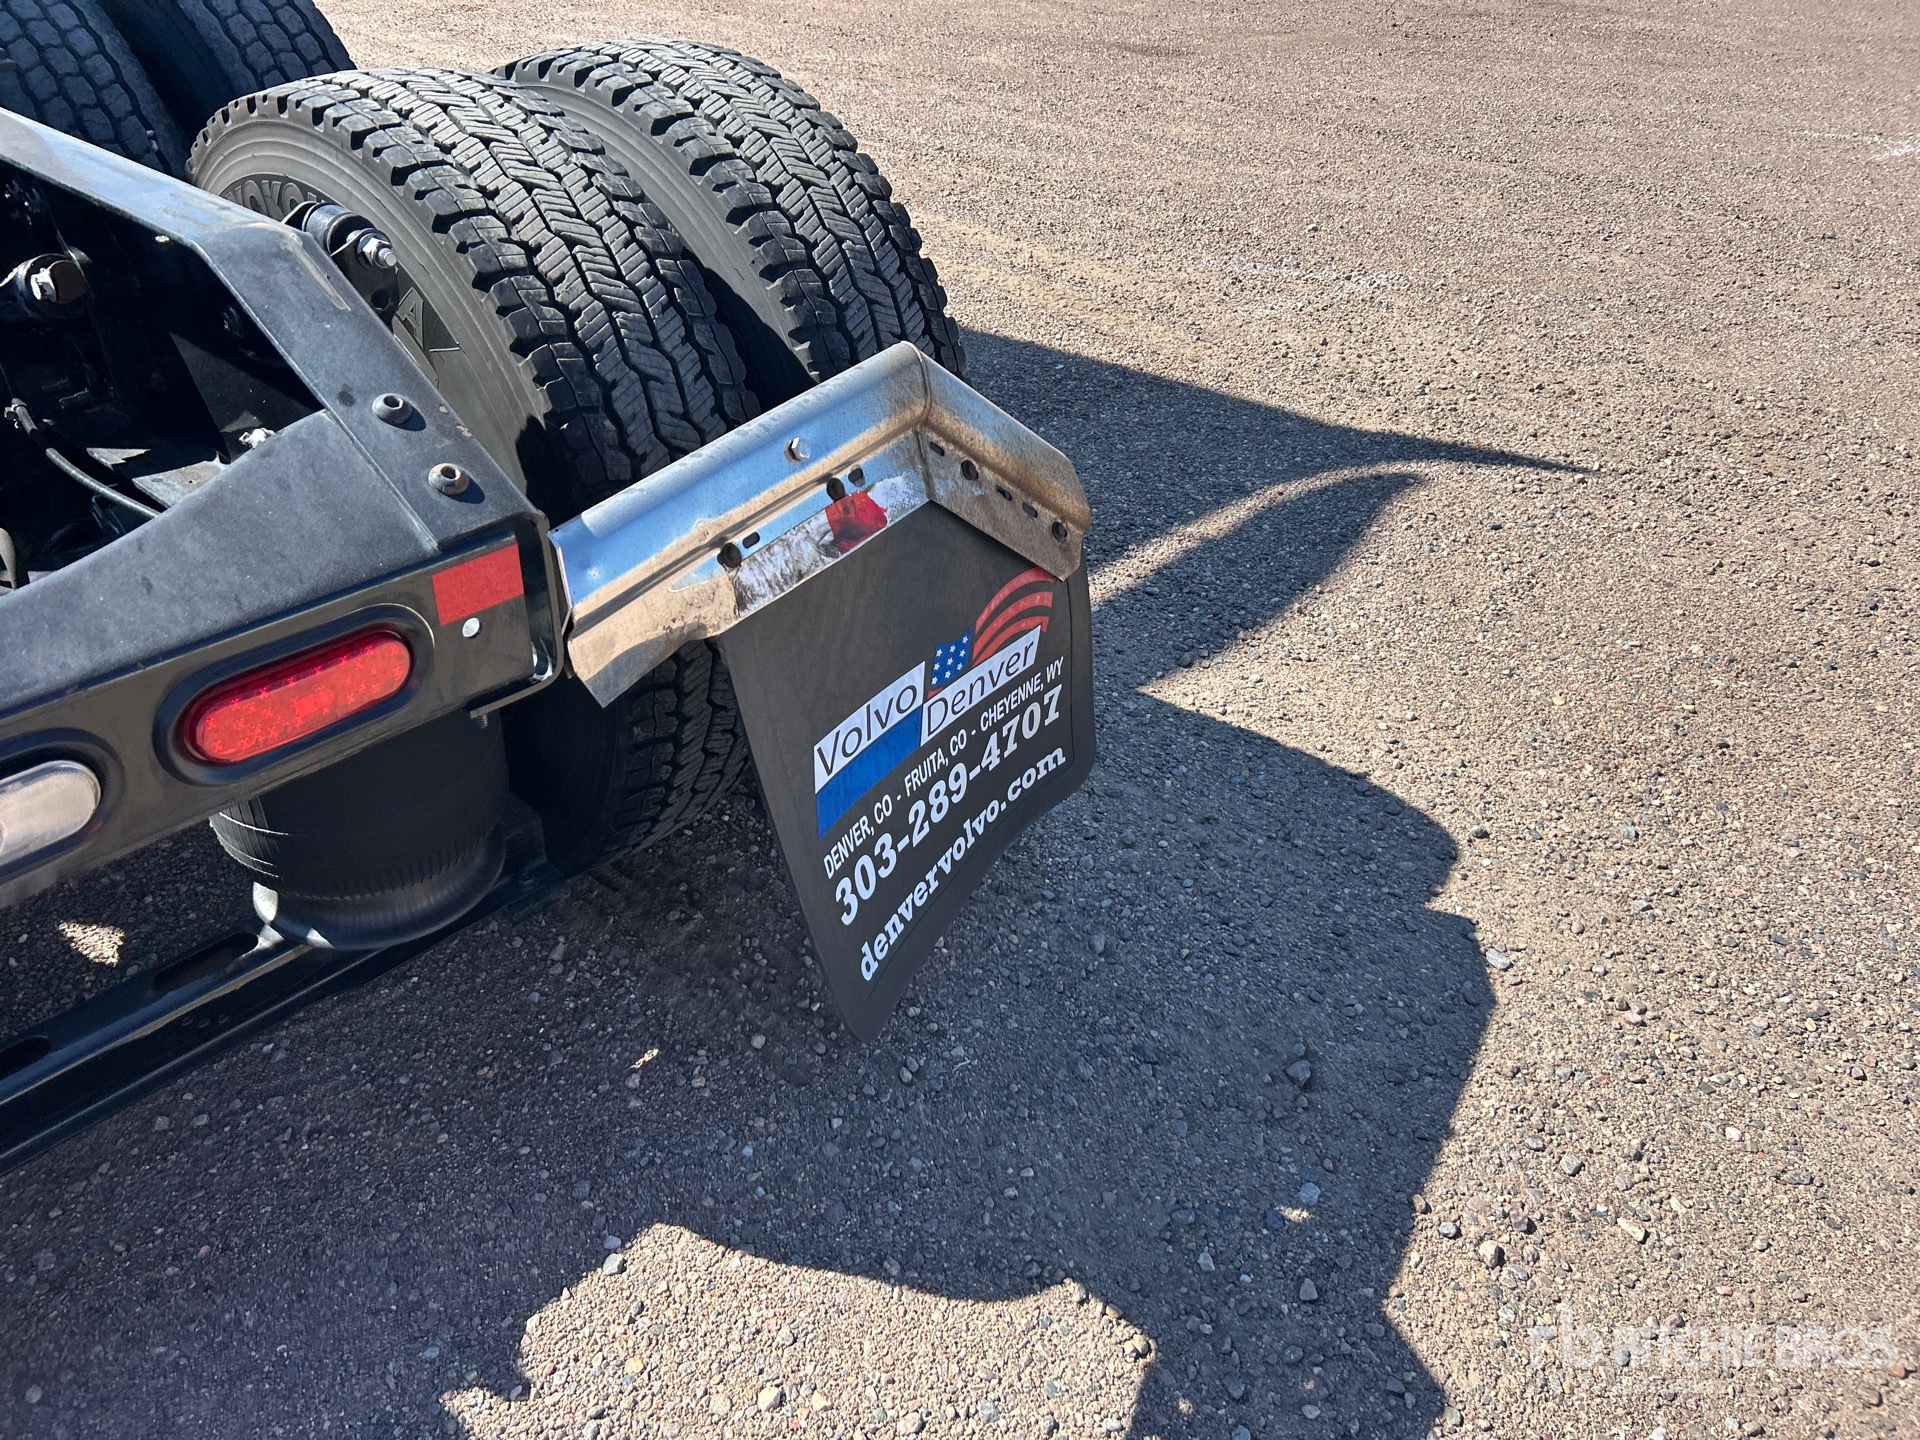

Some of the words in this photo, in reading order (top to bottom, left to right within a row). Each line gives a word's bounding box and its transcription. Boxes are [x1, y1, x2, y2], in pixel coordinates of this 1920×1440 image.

[818, 685, 917, 776] Volvo
[824, 816, 873, 879] DENVER,
[873, 794, 893, 825] CO
[905, 748, 949, 796] FRUITA,
[949, 727, 968, 757] CO
[980, 672, 1044, 731] CHEYENNE,
[1045, 656, 1065, 683] WY
[926, 642, 1034, 737] Denver
[835, 685, 1062, 926] 303-289-4707
[860, 748, 1066, 981] denvervolvo.com
